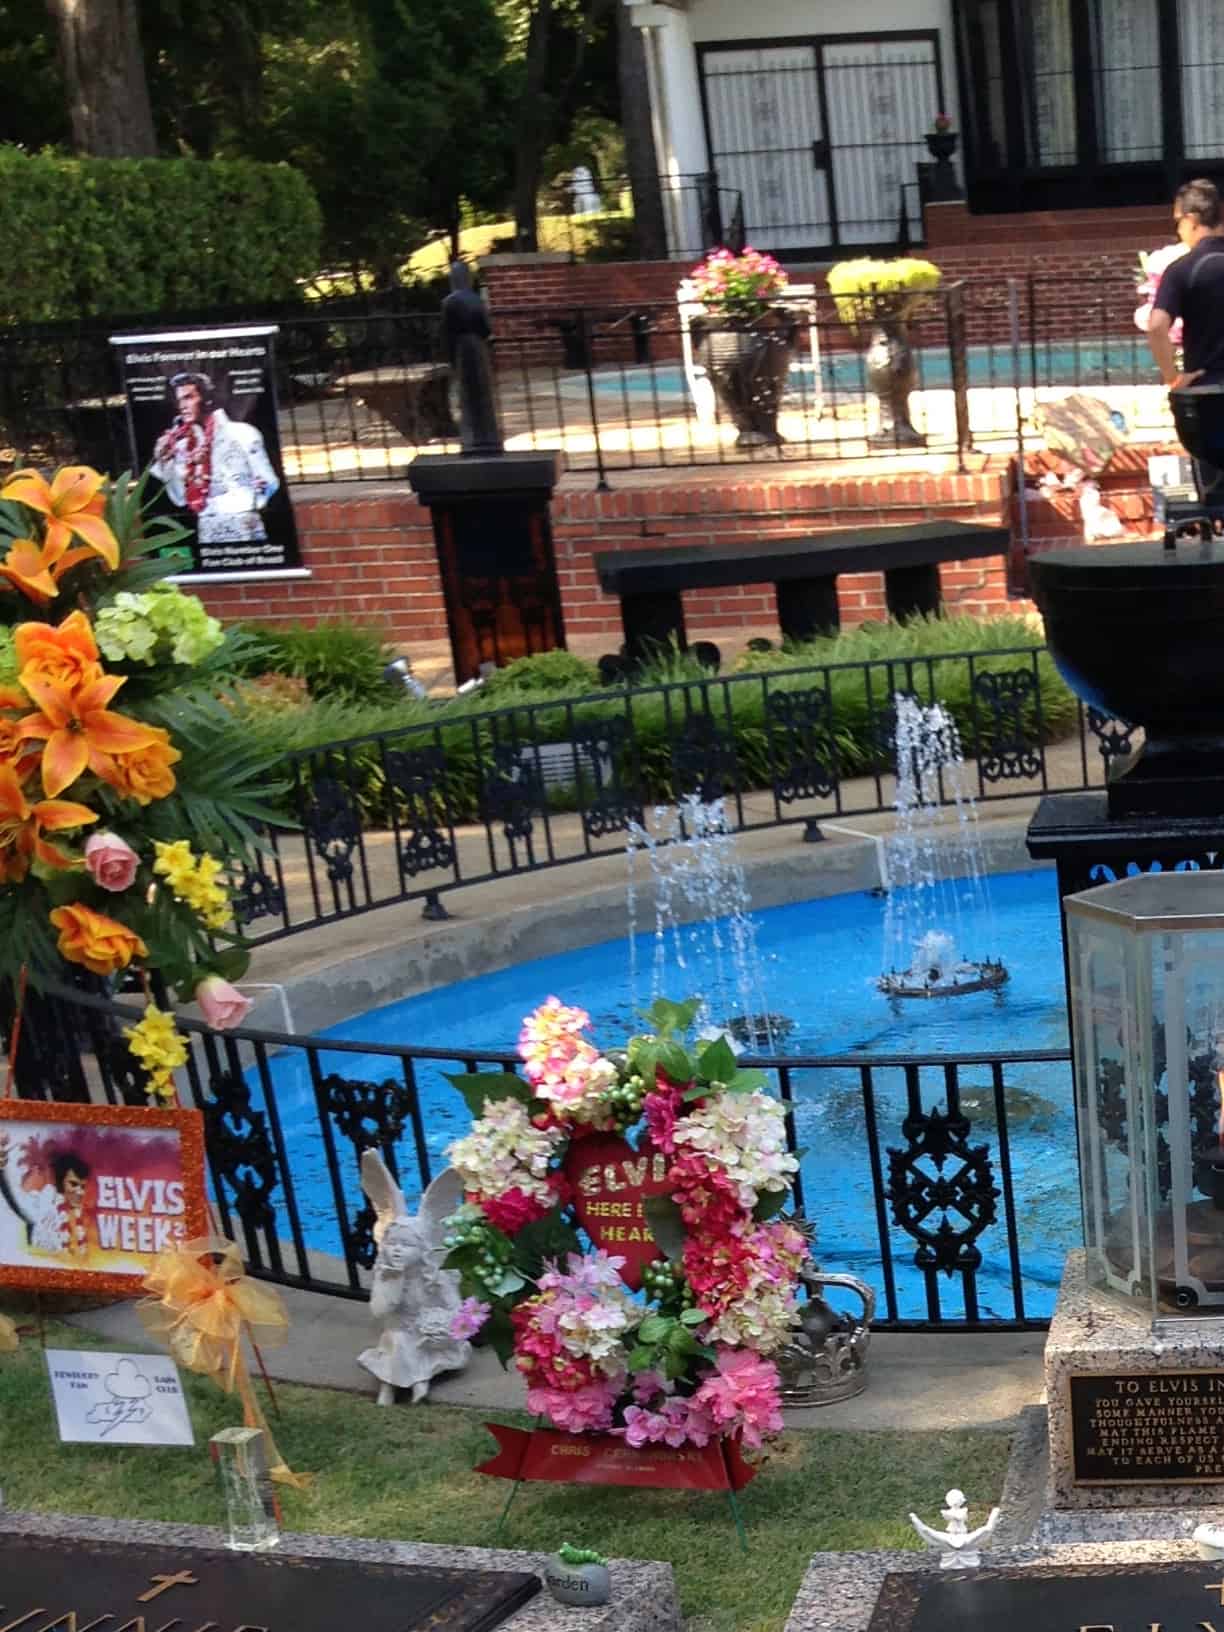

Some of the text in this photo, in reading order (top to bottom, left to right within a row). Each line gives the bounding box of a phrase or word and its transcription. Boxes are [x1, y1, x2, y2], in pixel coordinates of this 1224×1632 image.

[578, 1153, 665, 1197] ELVI
[96, 1175, 185, 1216] ELVIS
[585, 1201, 632, 1217] HERE
[1115, 1380, 1139, 1394] TO
[1149, 1379, 1199, 1393] ELVIS
[1125, 1397, 1161, 1407] GAVE
[1136, 1455, 1172, 1465] EACH
[1178, 1455, 1194, 1464] OF
[1199, 1454, 1214, 1464] US
